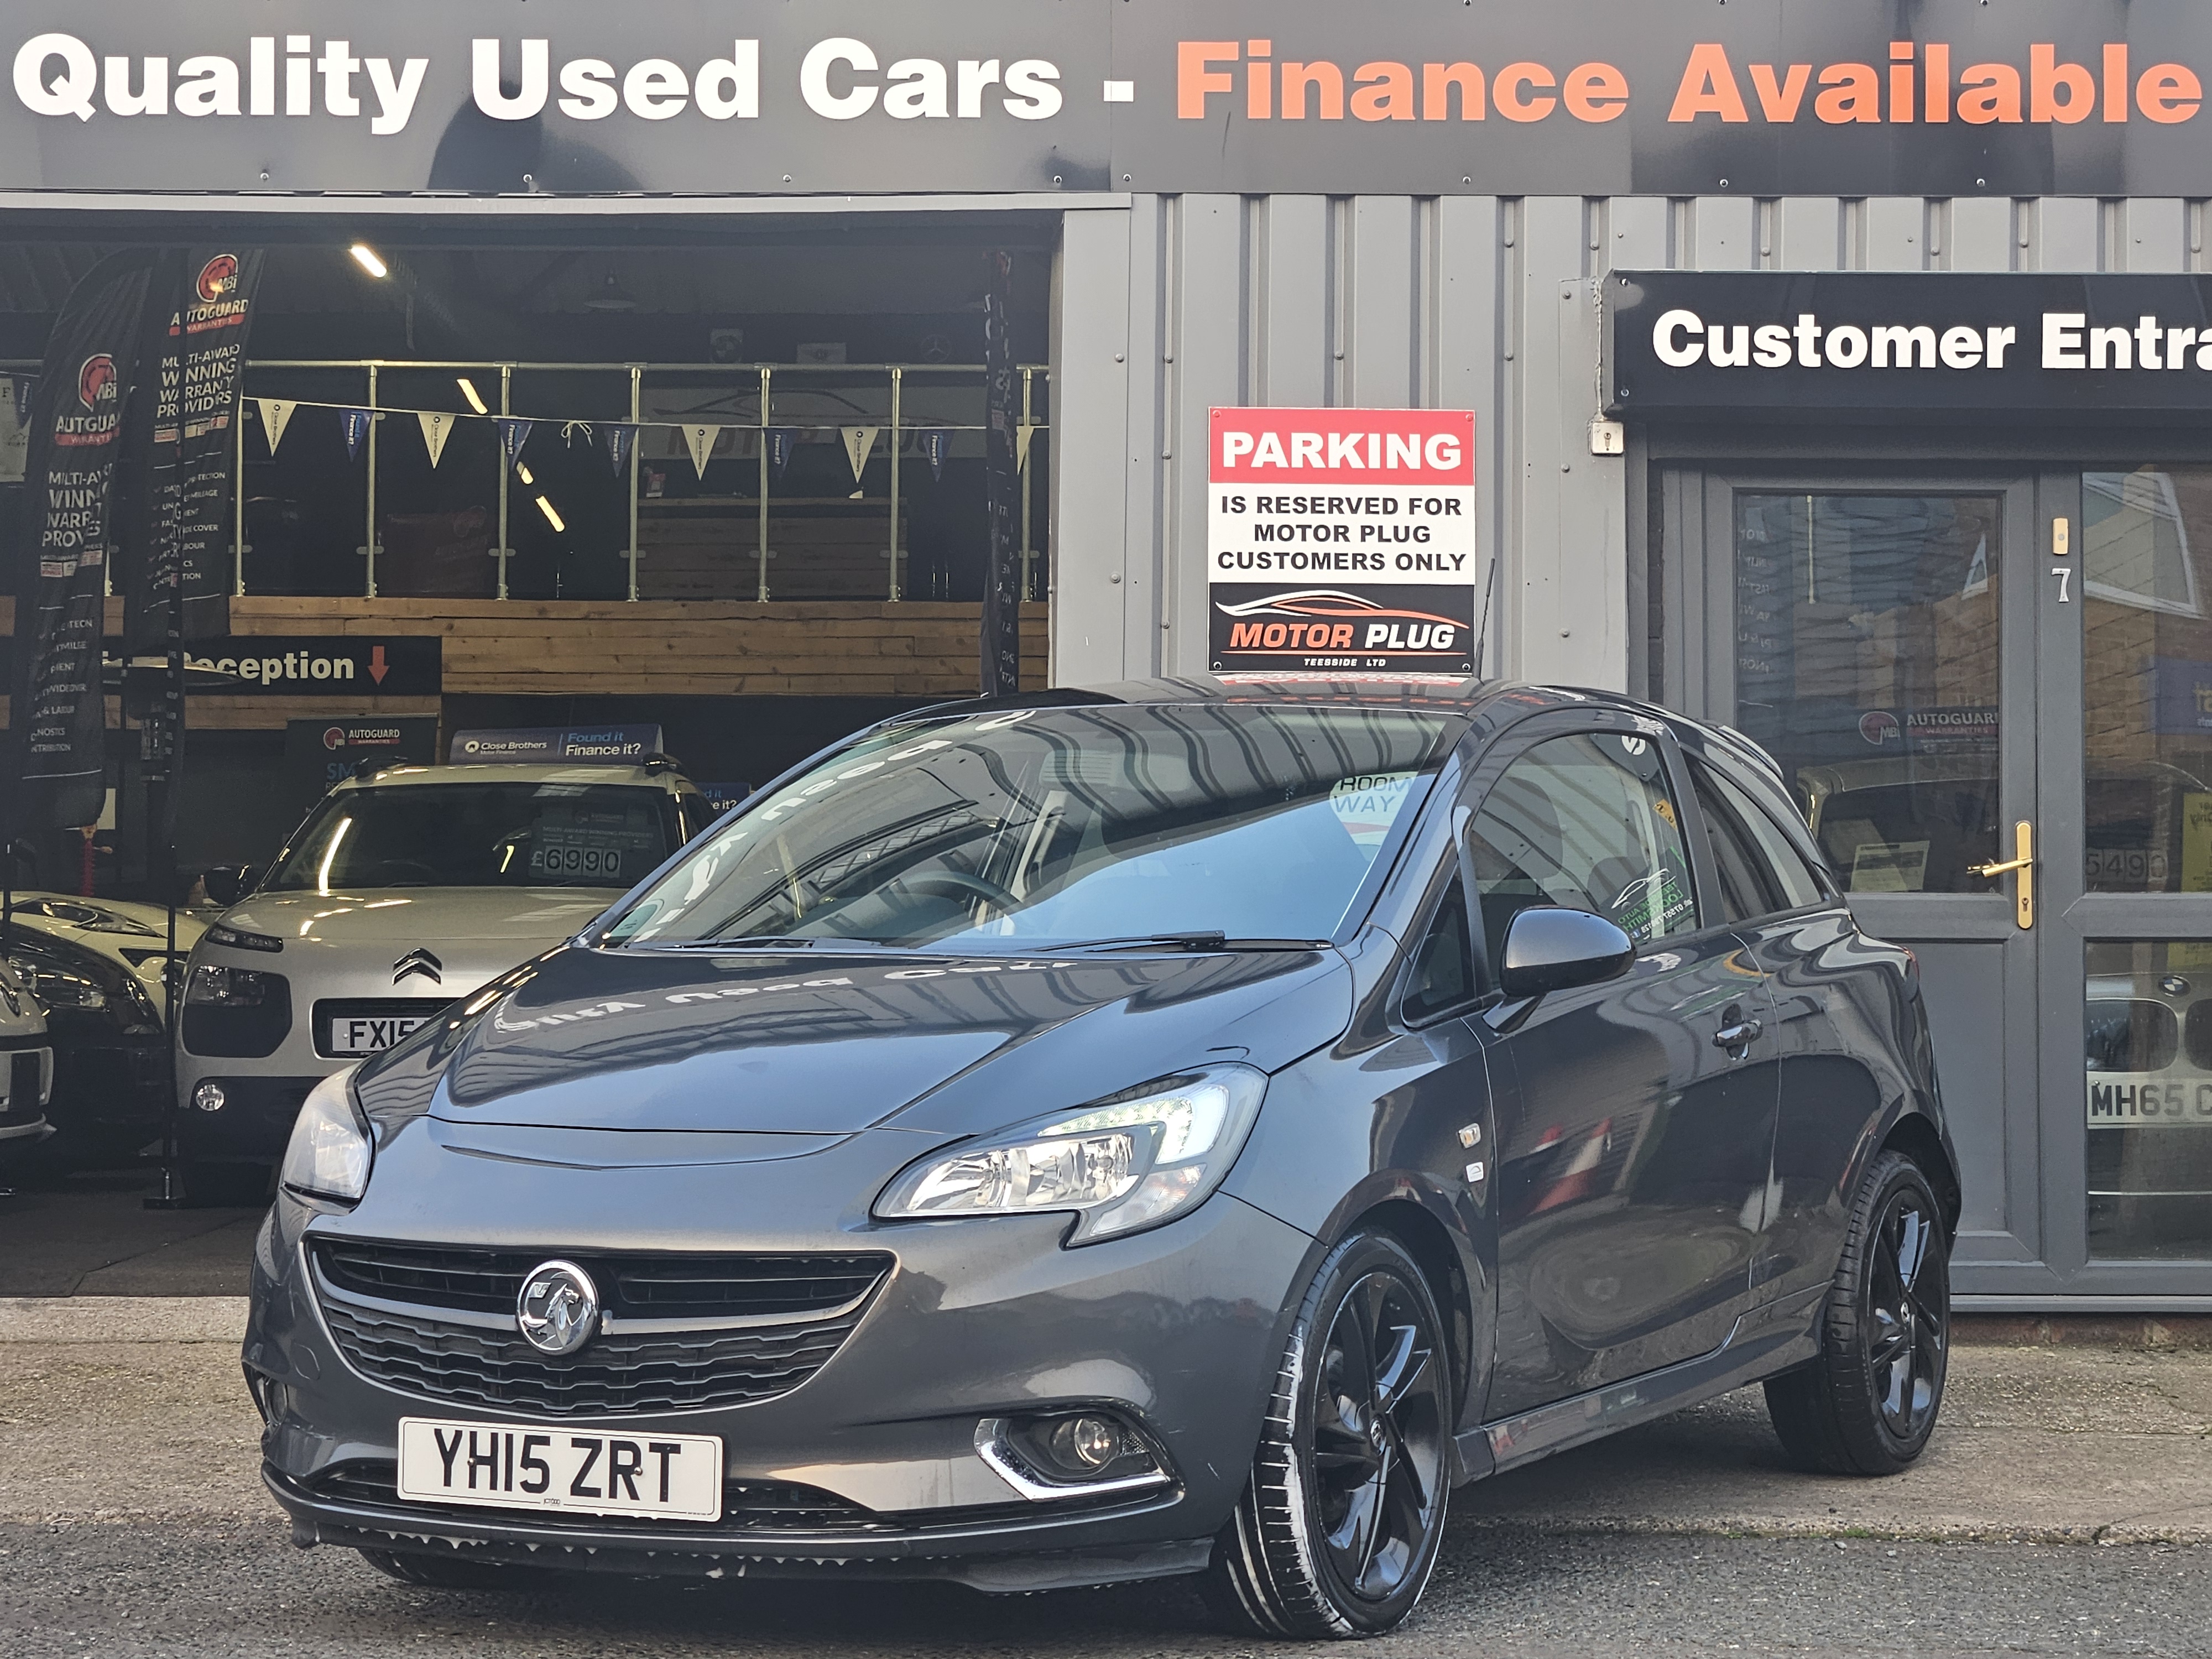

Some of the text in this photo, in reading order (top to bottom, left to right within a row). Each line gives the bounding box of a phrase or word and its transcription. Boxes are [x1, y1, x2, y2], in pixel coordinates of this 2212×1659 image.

[13, 33, 2203, 135] Quality Used Cars - Finance Available
[1653, 310, 2015, 369] Customer
[1223, 431, 1462, 470] PARKING
[1222, 496, 1462, 515] IS RESERVED FOR
[1254, 524, 1431, 543] MOTOR PLUG
[1218, 551, 1467, 571] CUSTOMERS ONLY
[2051, 568, 2072, 603] 7
[1229, 623, 1455, 649] MOTOR PLUG
[1304, 658, 1386, 667] TEESSIDE LTD
[349, 729, 400, 738] AUTOGUARD
[567, 732, 624, 743] Found it
[481, 742, 547, 751] Close Brothers
[566, 743, 641, 756] Finance it?
[1334, 796, 1396, 813] WAY
[2091, 1084, 2184, 1117] MH65
[434, 1428, 681, 1503] YH15 ZRT
